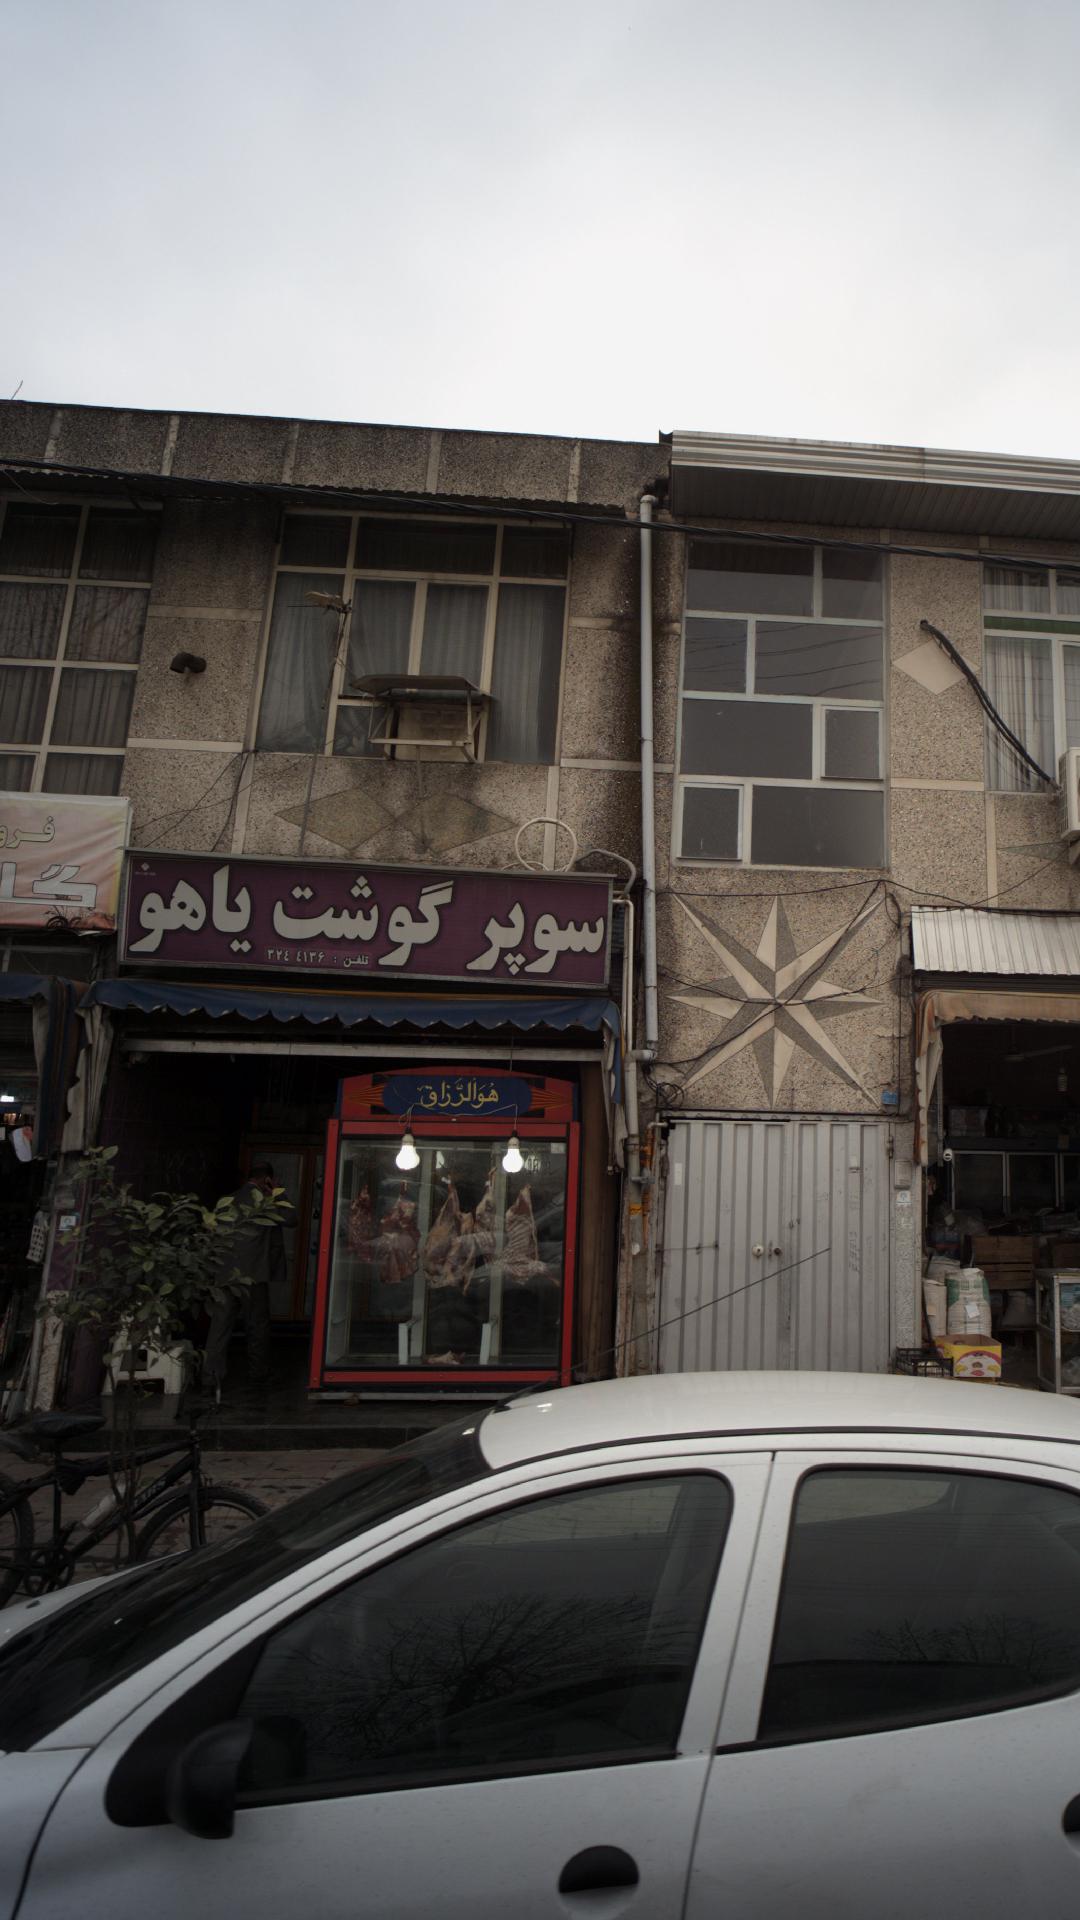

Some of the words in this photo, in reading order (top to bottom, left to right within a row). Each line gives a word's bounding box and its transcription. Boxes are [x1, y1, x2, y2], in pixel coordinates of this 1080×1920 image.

[273, 875, 455, 967] گوشت
[466, 900, 604, 975] سوپر
[343, 955, 369, 968] تلفن
